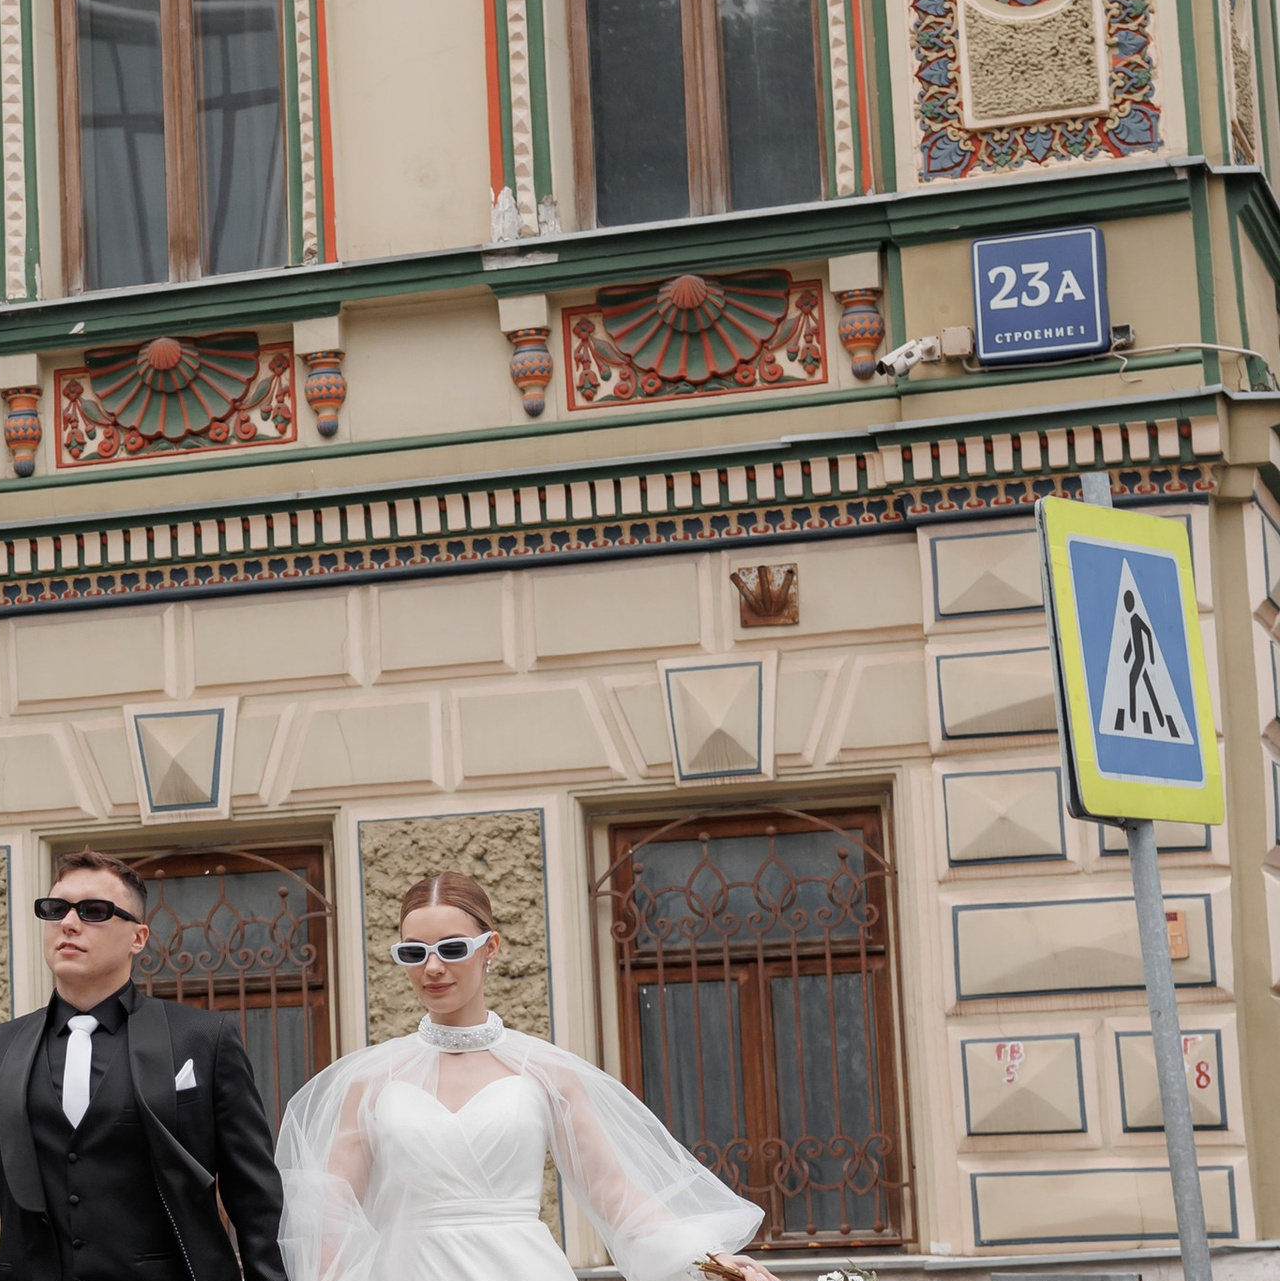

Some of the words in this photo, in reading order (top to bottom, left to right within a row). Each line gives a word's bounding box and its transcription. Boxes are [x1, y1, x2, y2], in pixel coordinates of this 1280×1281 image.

[995, 326, 1075, 344] СТРОЕНИЕ
[1079, 325, 1085, 335] 1
[1195, 1060, 1211, 1090] 8
